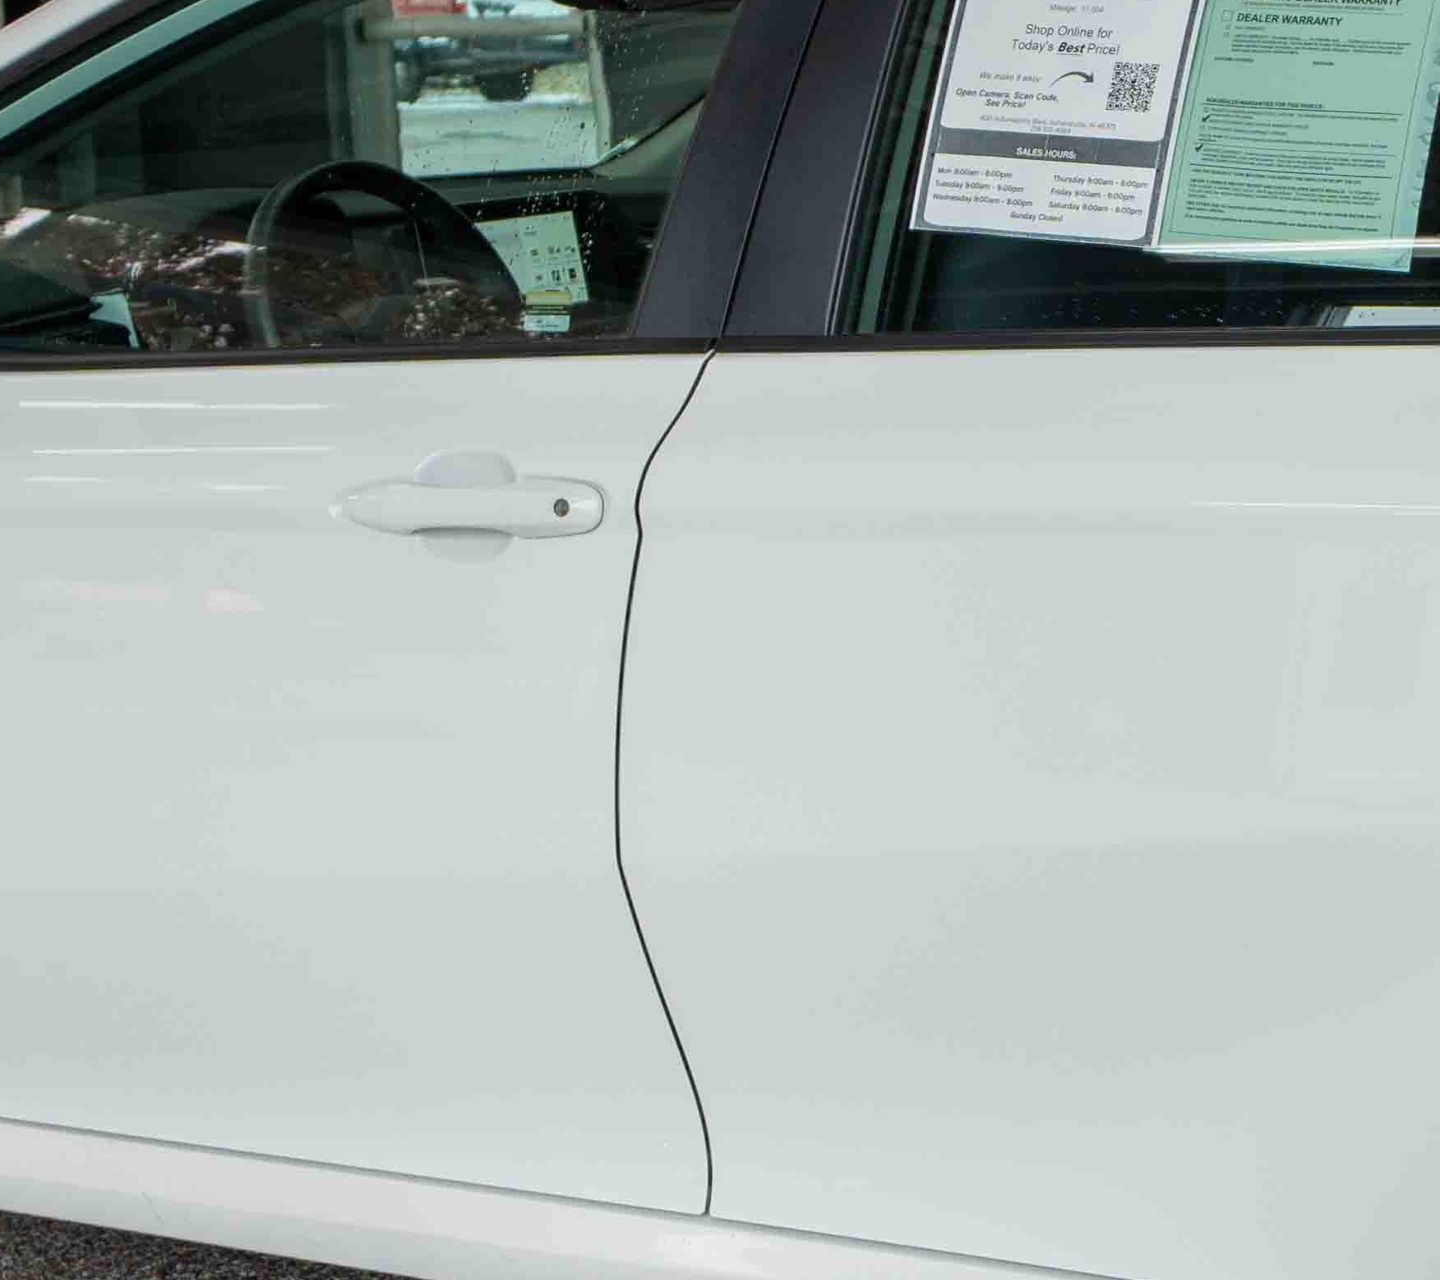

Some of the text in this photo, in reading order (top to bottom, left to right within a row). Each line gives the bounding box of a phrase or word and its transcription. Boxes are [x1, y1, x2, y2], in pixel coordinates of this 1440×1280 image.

[1236, 12, 1344, 27] DEALER WARRANTY
[1025, 23, 1114, 39] Shop Online for
[1011, 38, 1121, 56] Today's Best Price!
[1013, 91, 1034, 101] Scan
[1016, 146, 1044, 157] SALES
